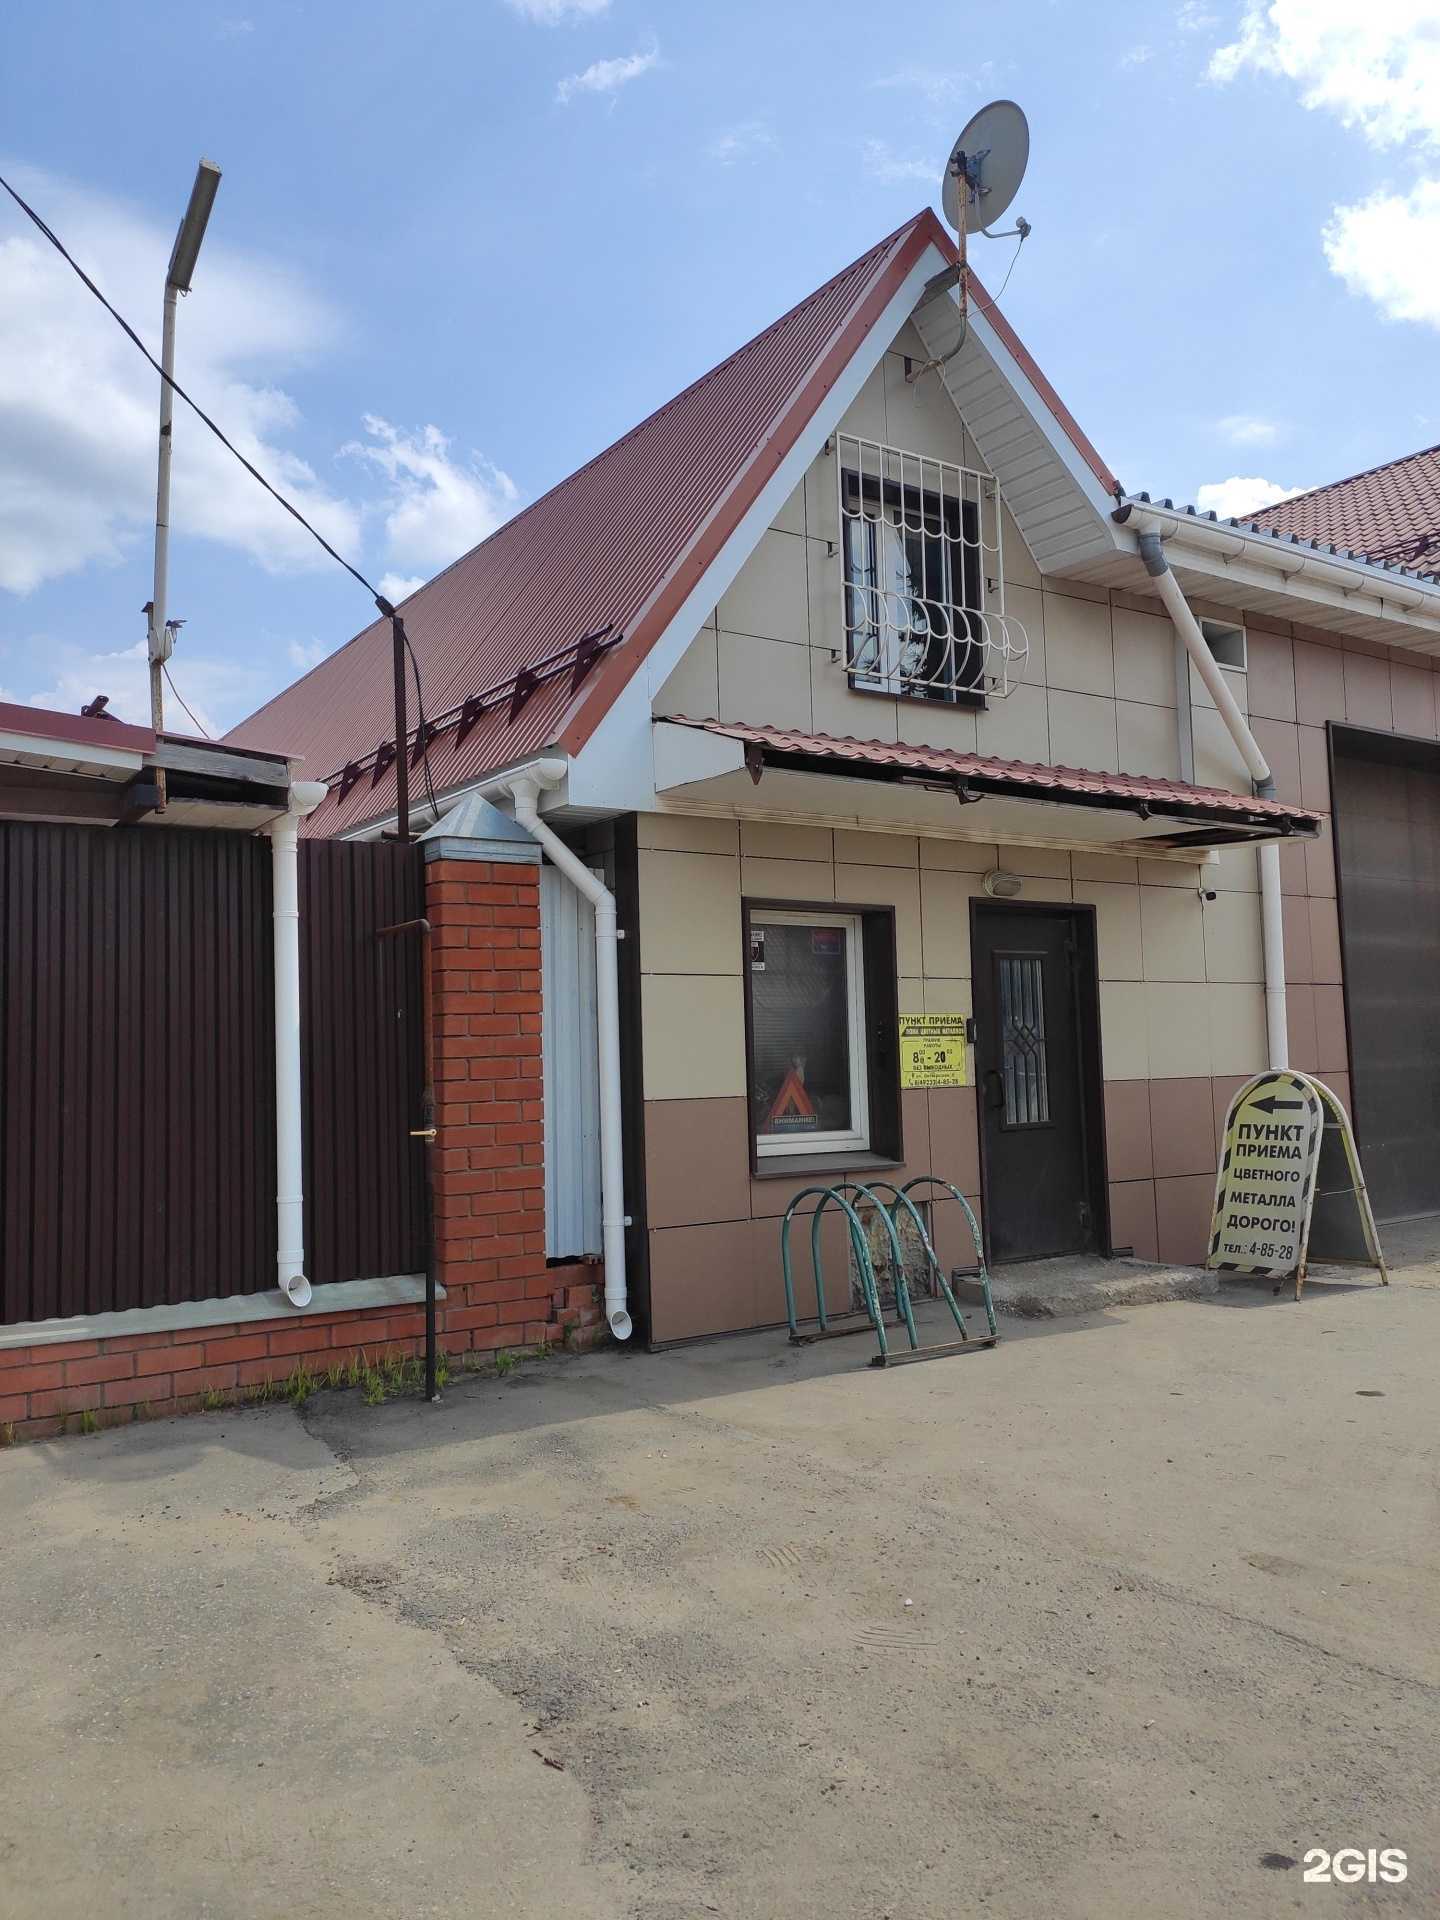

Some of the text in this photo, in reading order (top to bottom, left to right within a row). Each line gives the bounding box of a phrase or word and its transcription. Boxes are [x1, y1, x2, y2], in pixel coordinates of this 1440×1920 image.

[899, 1016, 926, 1025] ПУНКТ
[1237, 1123, 1304, 1142] ПУНКТ
[1235, 1143, 1302, 1160] ПРИЕМА
[1233, 1168, 1300, 1182] ЦВЕТНОГО
[1230, 1191, 1296, 1208] МЕТАЛЛА
[1226, 1214, 1296, 1233] ДОРОГО!
[1249, 1242, 1294, 1260] 4-85-28
